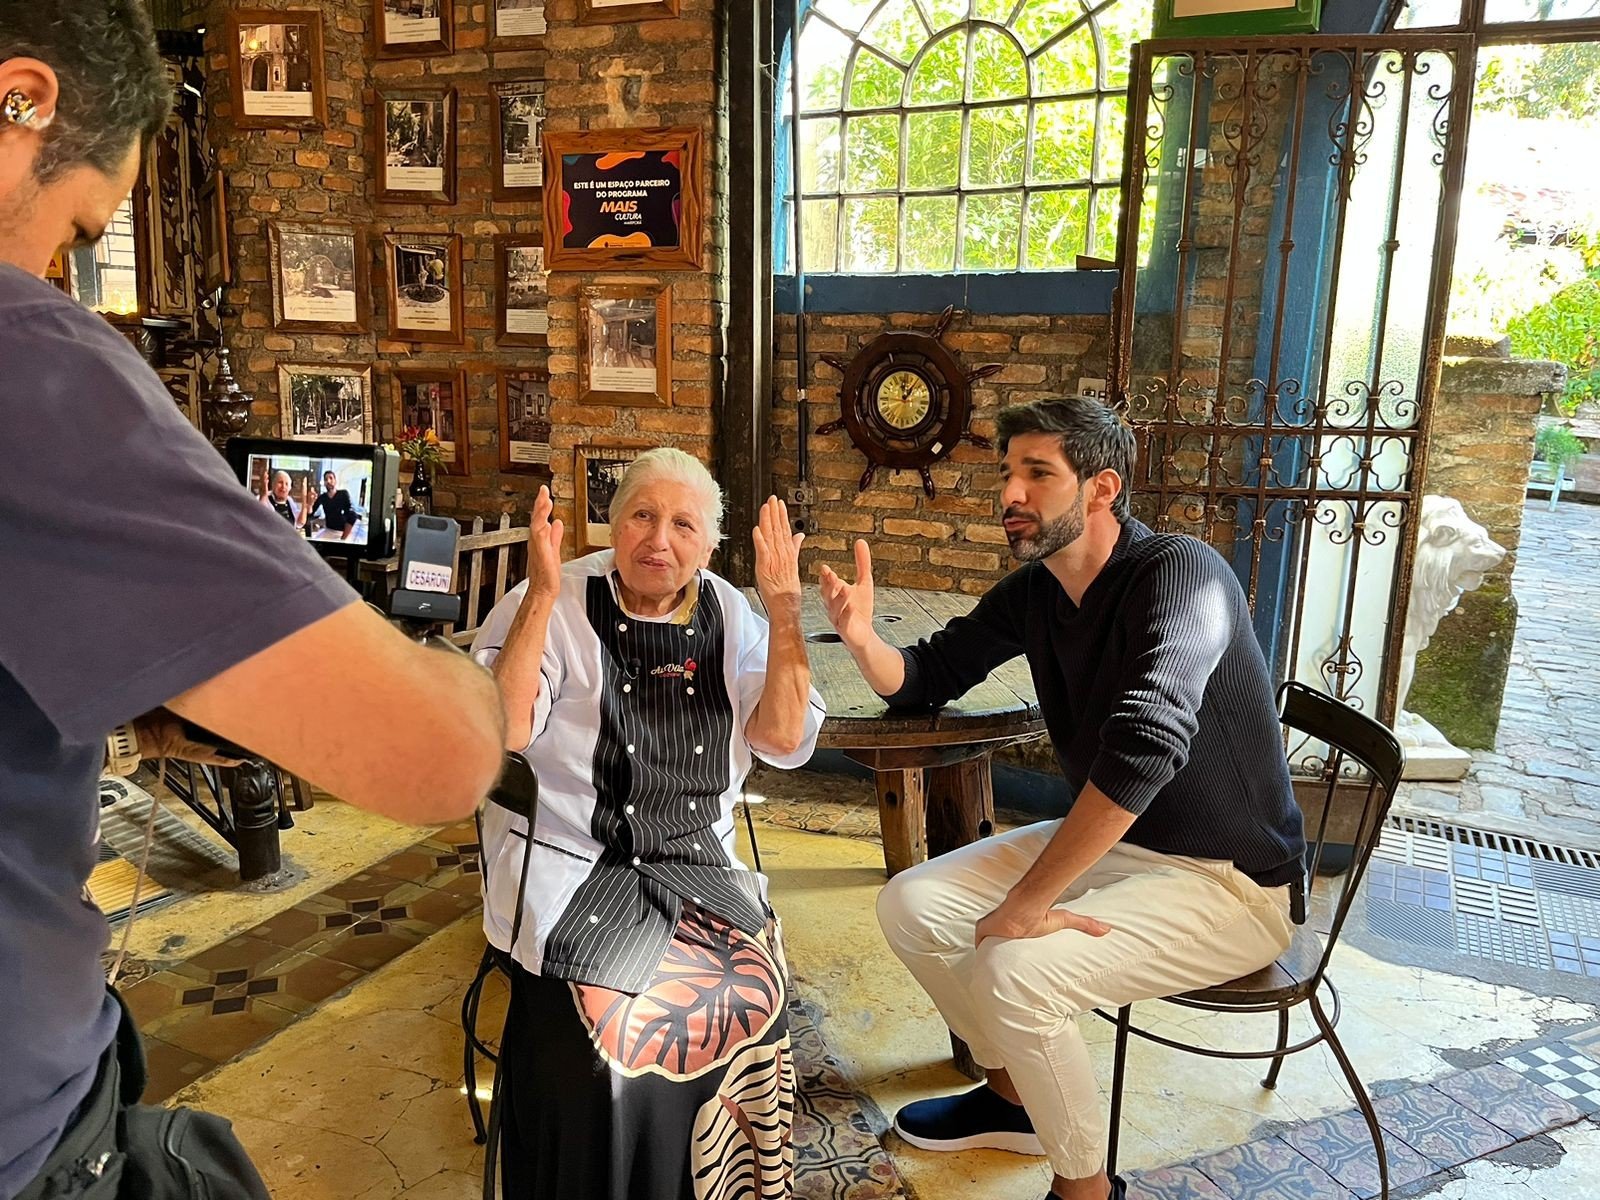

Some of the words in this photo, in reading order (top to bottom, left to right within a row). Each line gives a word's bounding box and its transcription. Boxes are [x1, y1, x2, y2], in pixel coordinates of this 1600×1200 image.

[573, 181, 589, 189] ESTE
[590, 180, 595, 189] É
[595, 181, 607, 189] UM
[608, 180, 634, 189] ESPAÇO
[635, 179, 670, 188] PARCEIRO
[608, 190, 648, 198] PROGRAMA
[600, 201, 637, 212] MAIS
